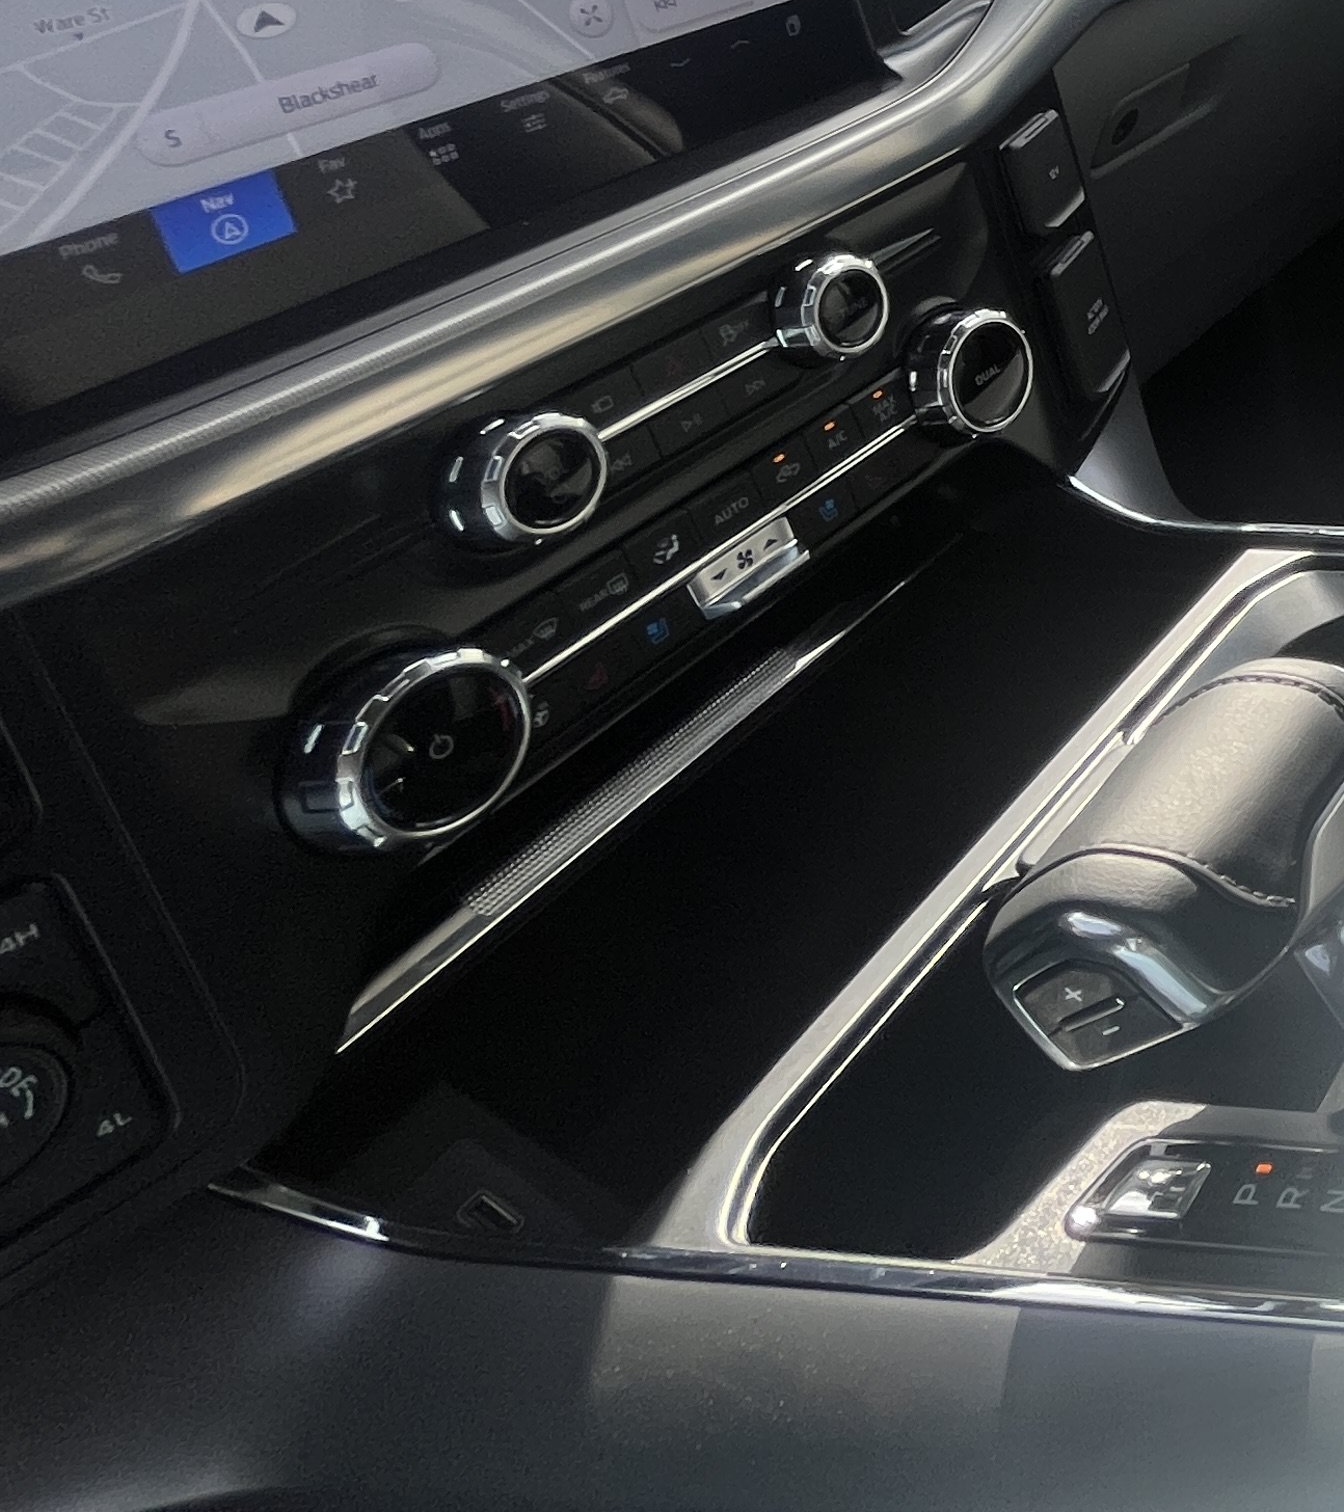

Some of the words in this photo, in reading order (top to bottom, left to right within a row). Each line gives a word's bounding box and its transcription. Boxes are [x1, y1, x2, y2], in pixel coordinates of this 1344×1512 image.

[33, 14, 86, 34] Ware
[86, 6, 111, 24] St
[277, 72, 380, 116] Blackshear
[163, 129, 183, 149] S
[200, 191, 235, 214] Nav
[57, 232, 120, 261] Phone
[973, 362, 1002, 387] DUAL
[827, 428, 849, 451] A/C
[713, 495, 750, 527] AUTO
[579, 588, 609, 613] REAR
[96, 1110, 134, 1138] 4L
[1231, 1181, 1257, 1205] P
[1275, 1188, 1303, 1209] R
